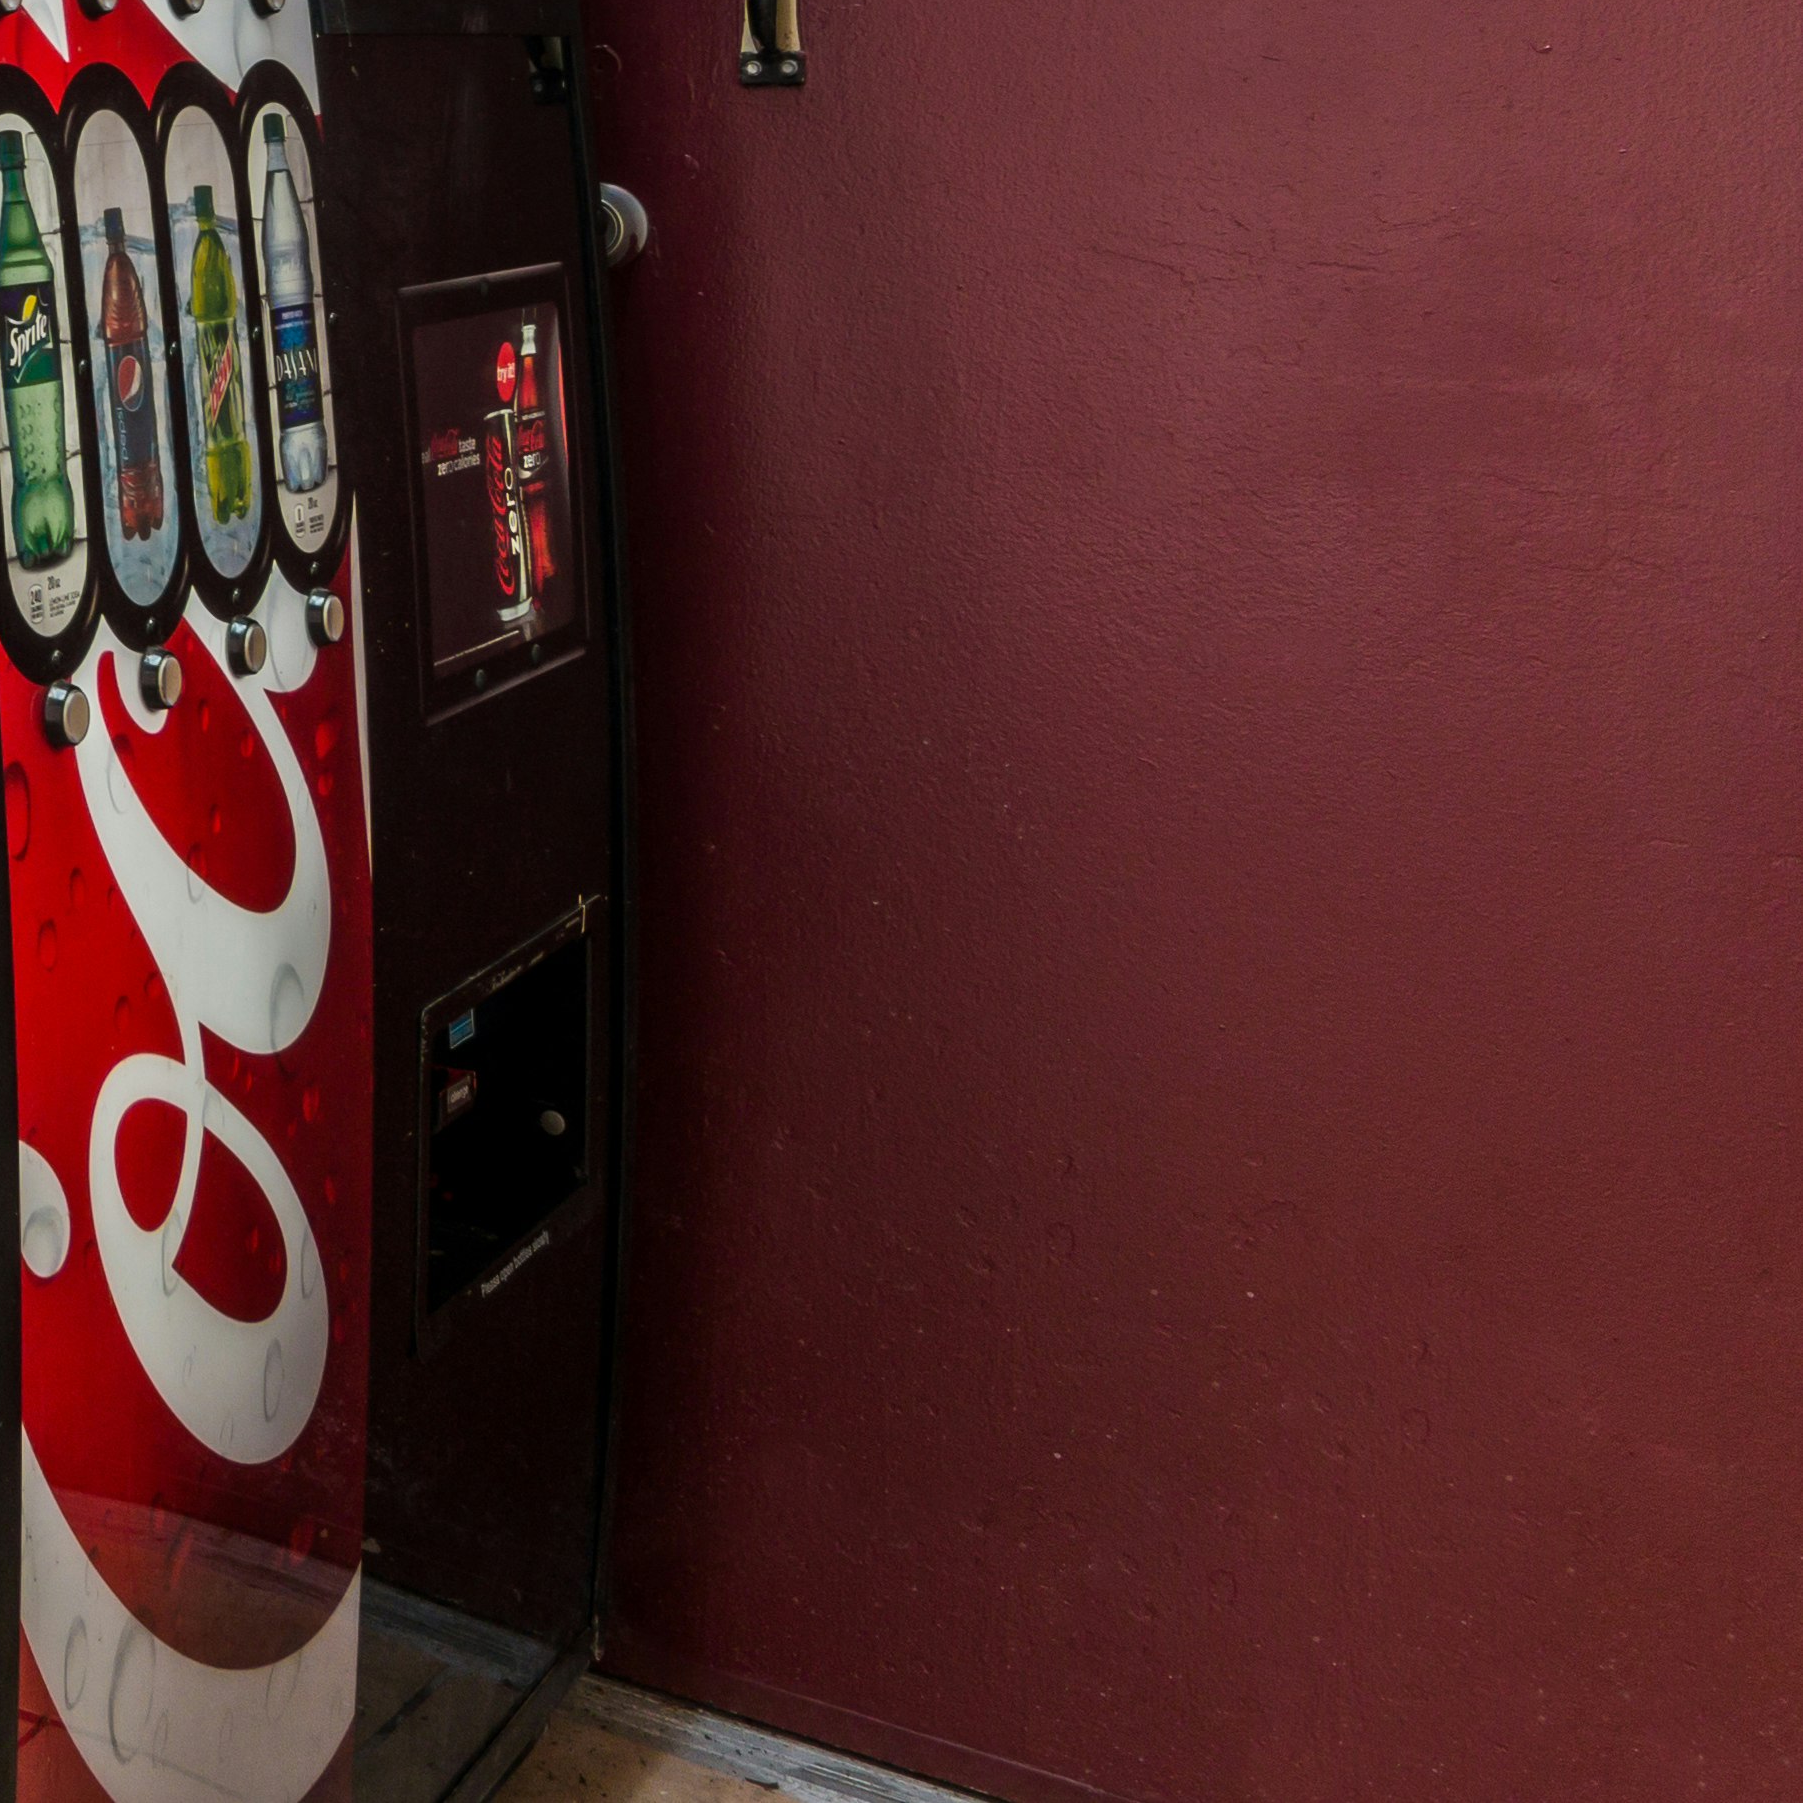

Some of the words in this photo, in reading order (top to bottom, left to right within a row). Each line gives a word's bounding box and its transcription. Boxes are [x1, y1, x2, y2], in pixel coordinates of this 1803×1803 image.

[10, 313, 47, 368] Sprite
[276, 348, 318, 381] DASANI
[497, 366, 507, 383] try
[458, 437, 476, 453] taste
[523, 452, 541, 468] zero
[437, 460, 454, 476] zero
[454, 453, 480, 472] calories
[487, 435, 515, 595] Coca-Cola
[504, 467, 520, 555] zero
[481, 1275, 500, 1298] Please
[500, 1262, 514, 1282] open
[513, 1245, 532, 1269] bottles
[532, 1230, 549, 1252] slowly
